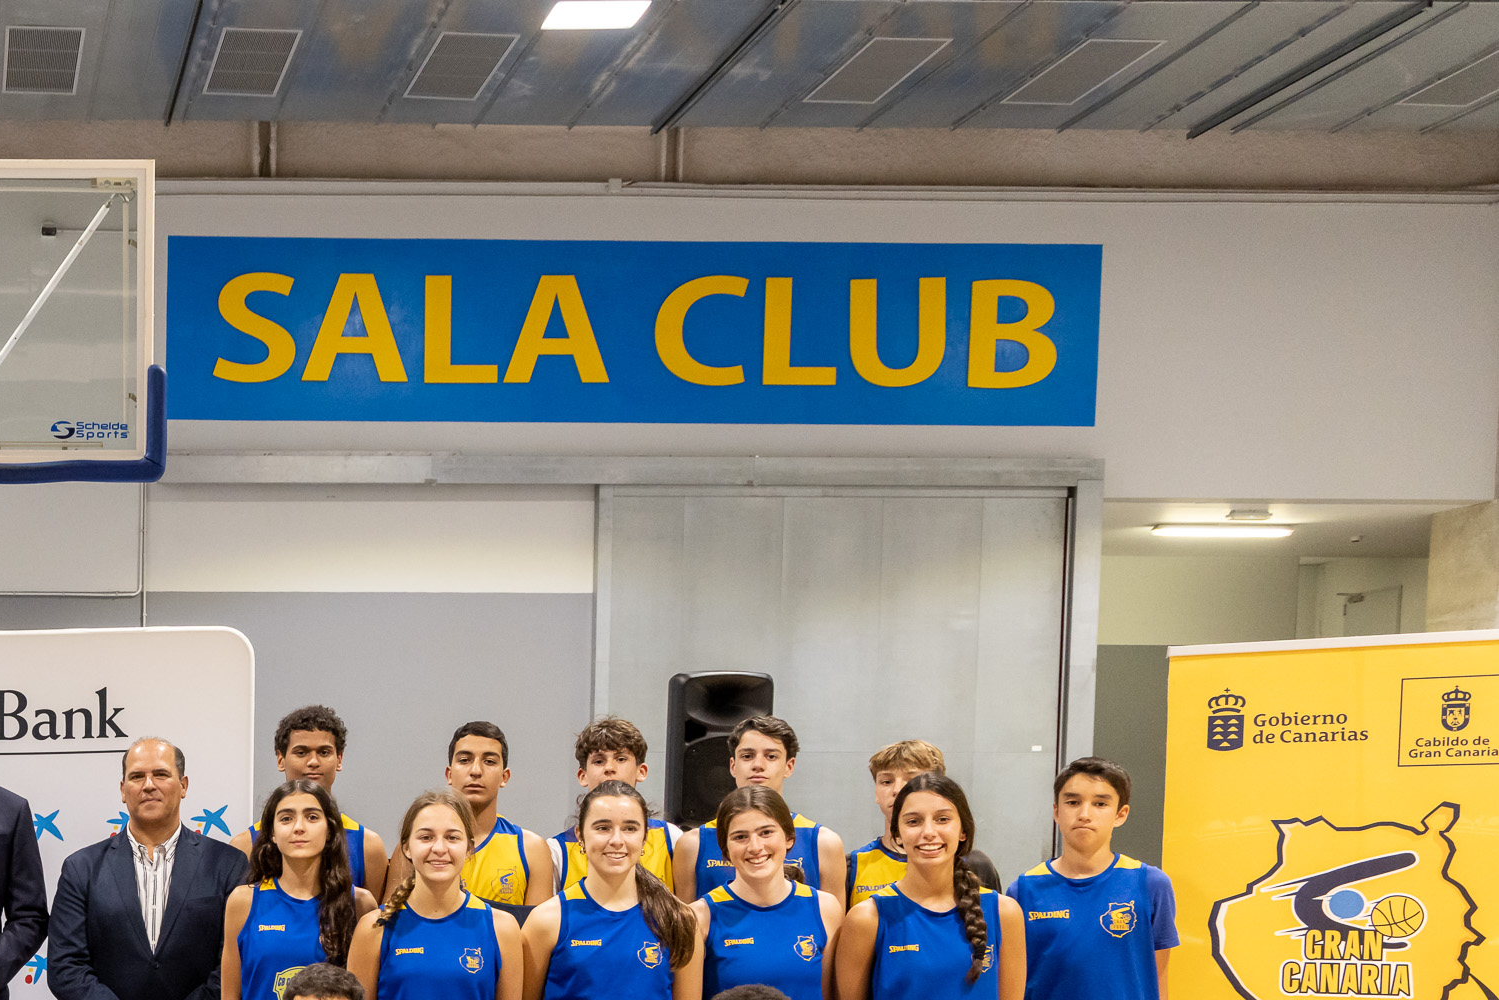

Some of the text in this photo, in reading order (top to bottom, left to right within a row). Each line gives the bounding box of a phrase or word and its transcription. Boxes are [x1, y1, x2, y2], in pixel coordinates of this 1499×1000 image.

[212, 272, 1059, 389] SALA CLUB
[76, 421, 128, 430] Schelde
[76, 430, 128, 440] Sports
[1253, 712, 1348, 728] Gobierno
[1252, 727, 1369, 744] de Canarias
[1415, 736, 1490, 747] Cabildo de
[1408, 746, 1499, 758] Gran Canaria
[706, 859, 735, 868] SPALD
[1029, 909, 1070, 921] SPALDING
[571, 939, 602, 947] SPALDING
[724, 938, 754, 947] SPALDING
[1304, 929, 1383, 961] GRAN
[396, 947, 424, 956] SPALDING
[889, 944, 920, 954] SPALDING
[1281, 962, 1412, 997] CANARIA
